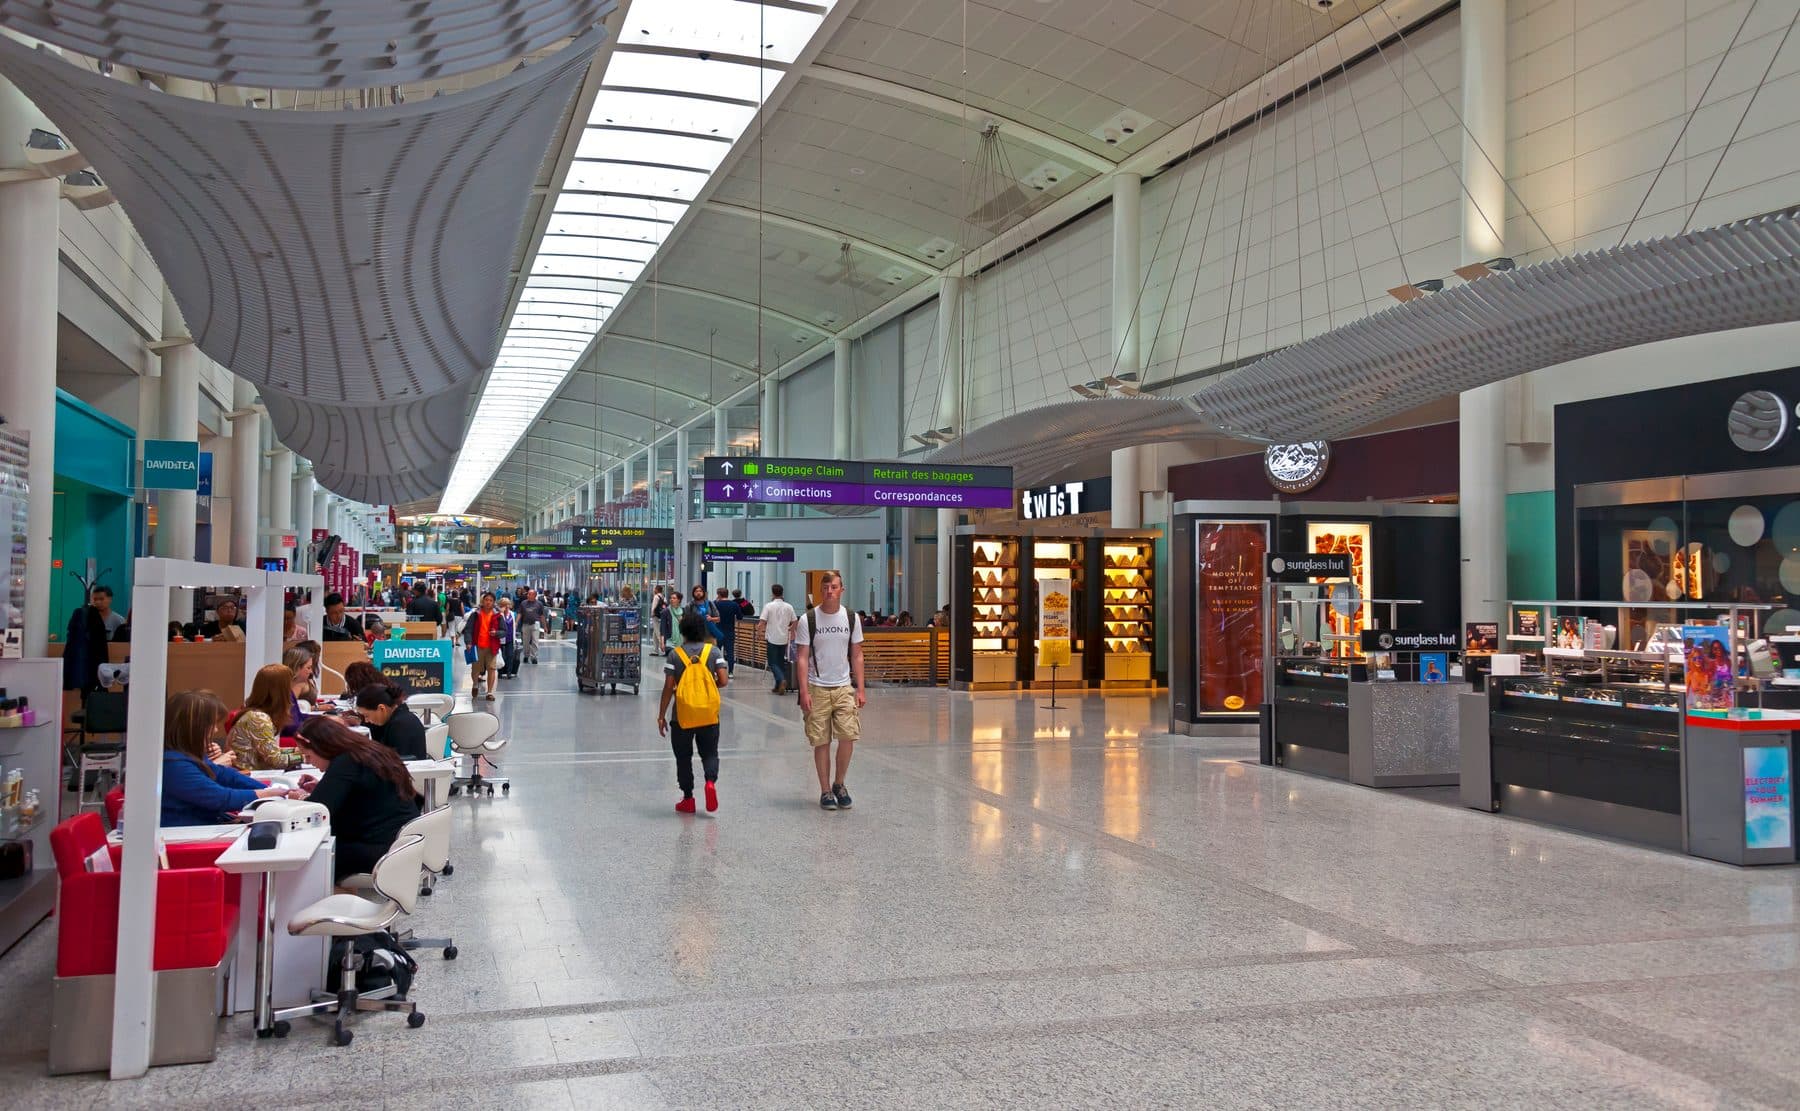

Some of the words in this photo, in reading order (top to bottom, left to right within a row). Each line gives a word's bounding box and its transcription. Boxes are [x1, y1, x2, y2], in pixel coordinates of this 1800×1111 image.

[146, 460, 196, 470] DAVIDsTEA
[766, 464, 813, 476] Baggage
[816, 466, 845, 477] Claim
[873, 469, 908, 479] Retrait
[912, 470, 929, 480] des
[932, 471, 974, 482] bagages
[766, 486, 832, 498] Connections
[874, 490, 963, 502] Correspondances
[1022, 482, 1083, 519] twisT
[1287, 559, 1327, 572] sunglass
[1329, 559, 1344, 570] hut
[816, 626, 843, 635] NIXON
[1395, 633, 1438, 648] sunglass
[1440, 633, 1456, 645] hut
[384, 648, 441, 659] DAVIDsTEA
